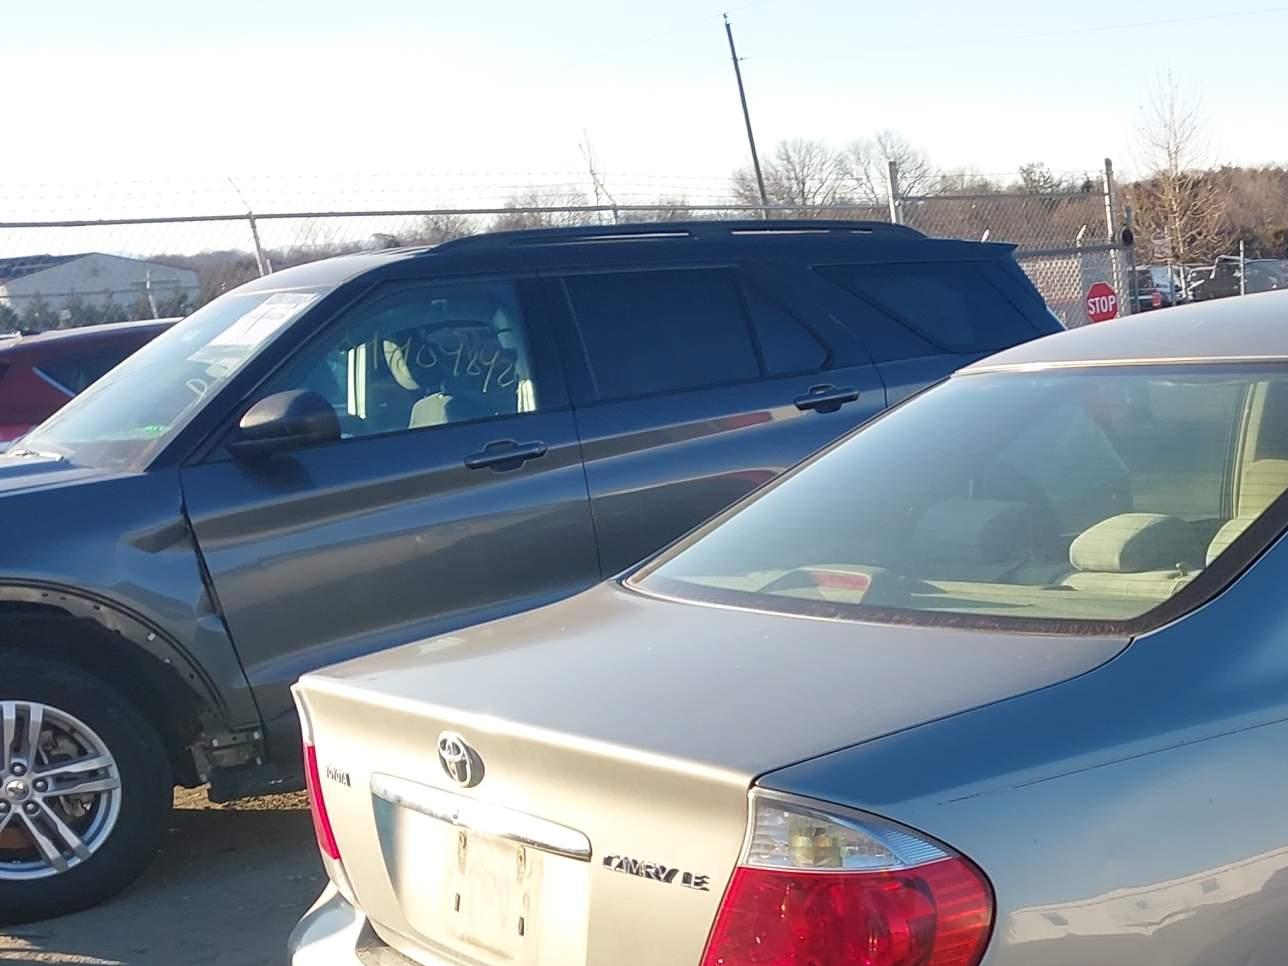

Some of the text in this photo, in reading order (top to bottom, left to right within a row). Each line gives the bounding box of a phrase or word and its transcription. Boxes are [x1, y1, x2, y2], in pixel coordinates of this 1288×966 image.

[1088, 294, 1116, 315] STOP
[602, 854, 711, 892] CAMRY LE
